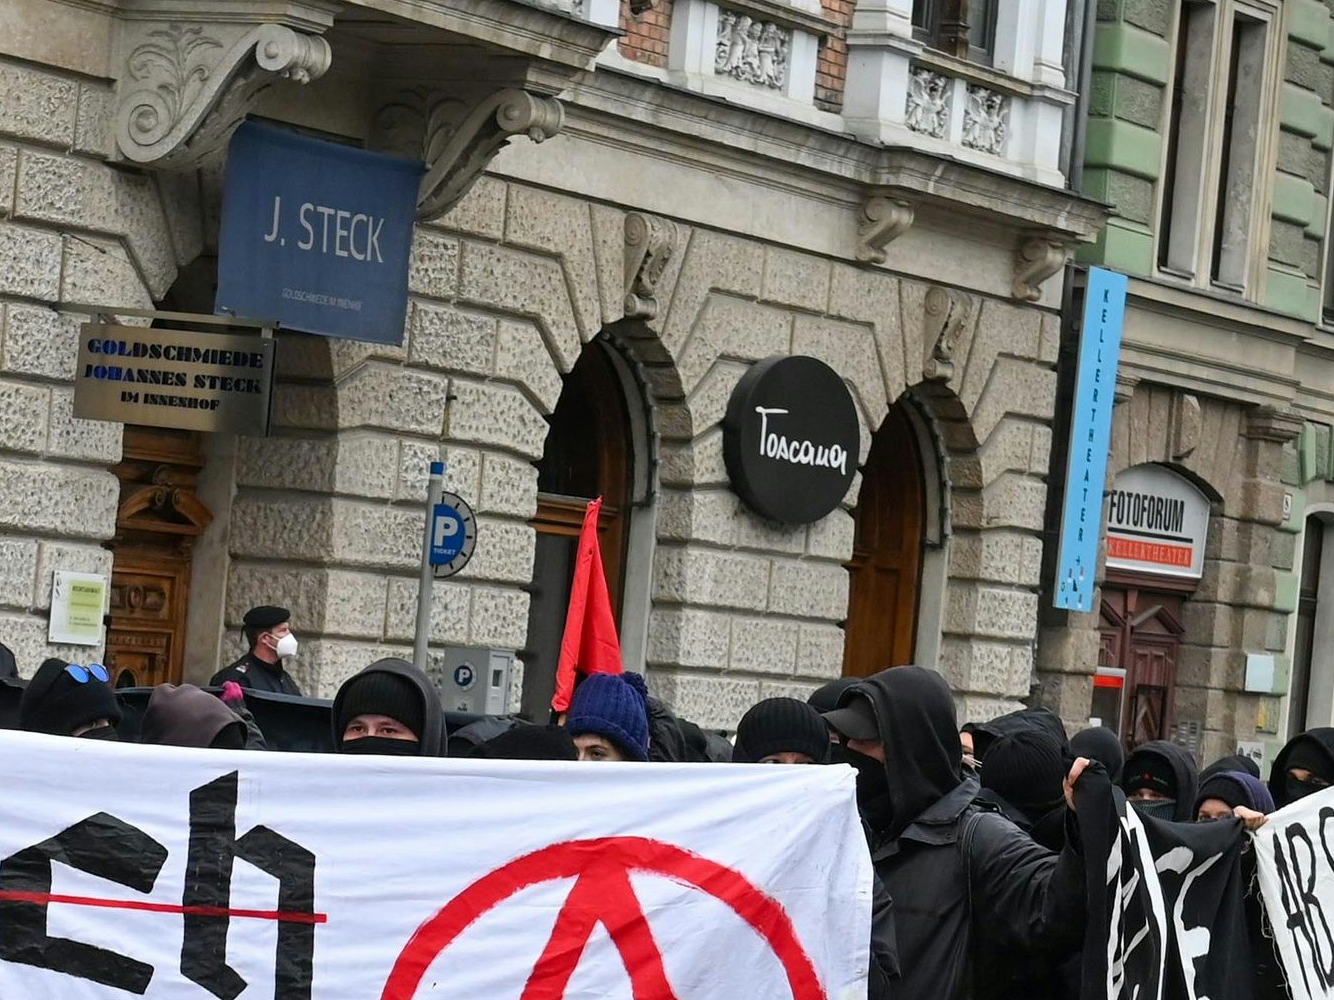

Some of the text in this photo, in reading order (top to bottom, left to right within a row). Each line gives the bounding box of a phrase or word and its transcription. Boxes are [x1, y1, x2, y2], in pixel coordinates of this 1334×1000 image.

[264, 195, 385, 263] J. STECK
[87, 338, 264, 369] GOLDSCHMIEDE
[83, 363, 262, 395] JOHANNES STECK
[120, 390, 220, 411] IM INNENHOF
[755, 406, 847, 475] Toscana
[1108, 489, 1185, 533] FOTOFORUM
[433, 516, 459, 547] P
[458, 668, 470, 683] P
